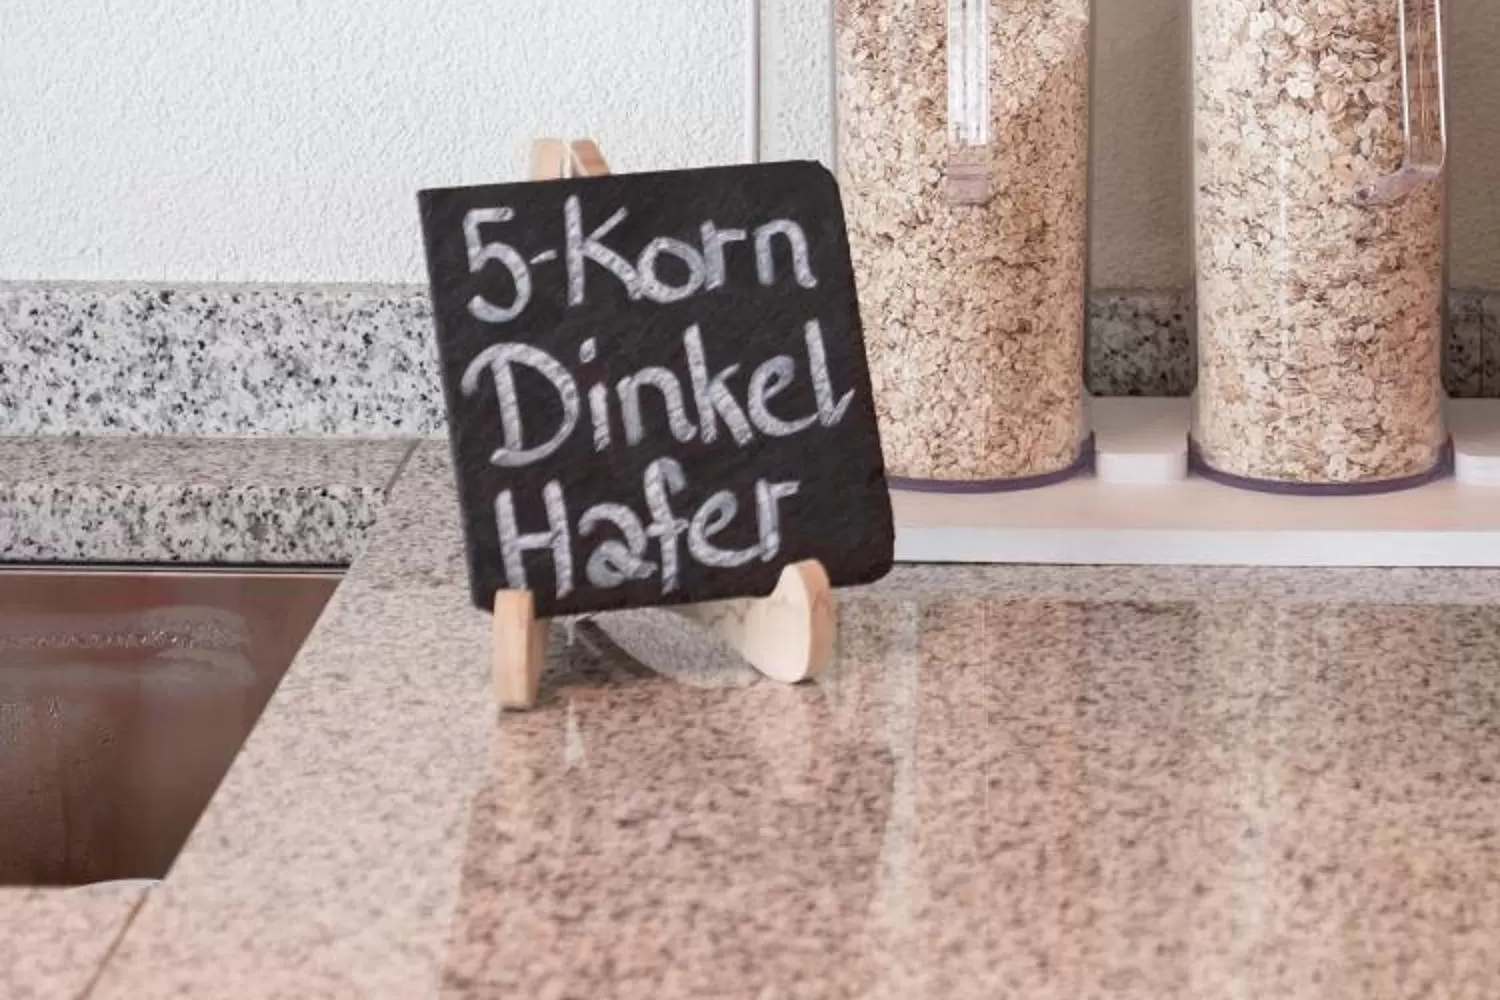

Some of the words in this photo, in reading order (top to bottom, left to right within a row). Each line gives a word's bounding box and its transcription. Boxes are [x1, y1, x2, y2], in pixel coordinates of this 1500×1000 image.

[462, 194, 816, 323] 5-Korn
[461, 318, 856, 468] Dinkel
[494, 455, 801, 601] Hafer
